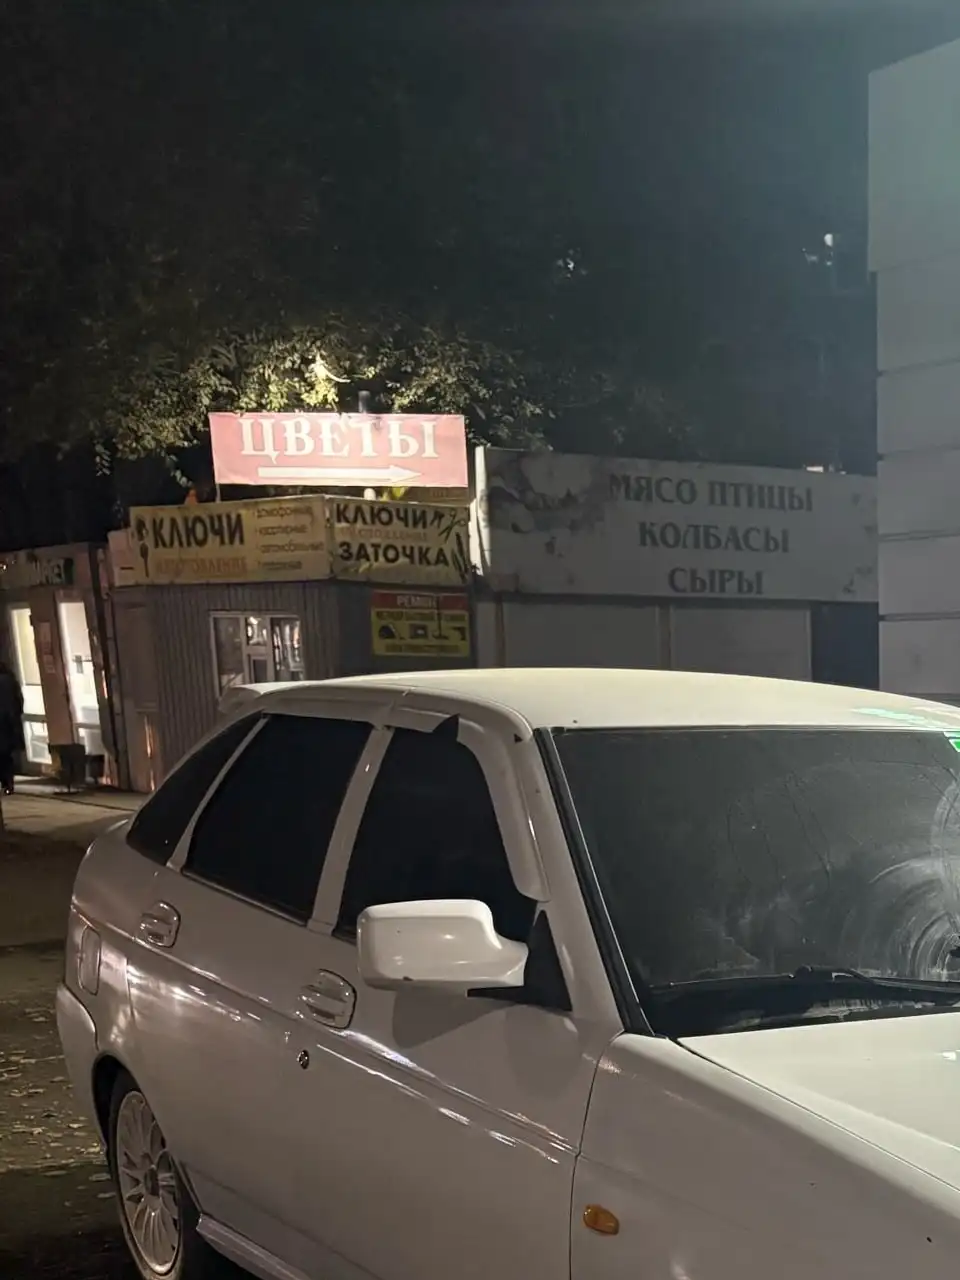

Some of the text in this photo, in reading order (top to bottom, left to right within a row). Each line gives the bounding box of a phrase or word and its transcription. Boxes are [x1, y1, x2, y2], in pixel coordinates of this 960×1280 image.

[237, 415, 440, 464] ЦВЕТЫ
[608, 474, 813, 513] МЯСО ПТИЦЫ
[152, 513, 244, 549] КЛЮЧИ
[335, 503, 427, 529] КЛЮЧИ
[638, 521, 790, 554] КОЛБАСЫ
[339, 541, 449, 568] ЗАТОЧКА
[667, 567, 764, 595] СЫРЫ
